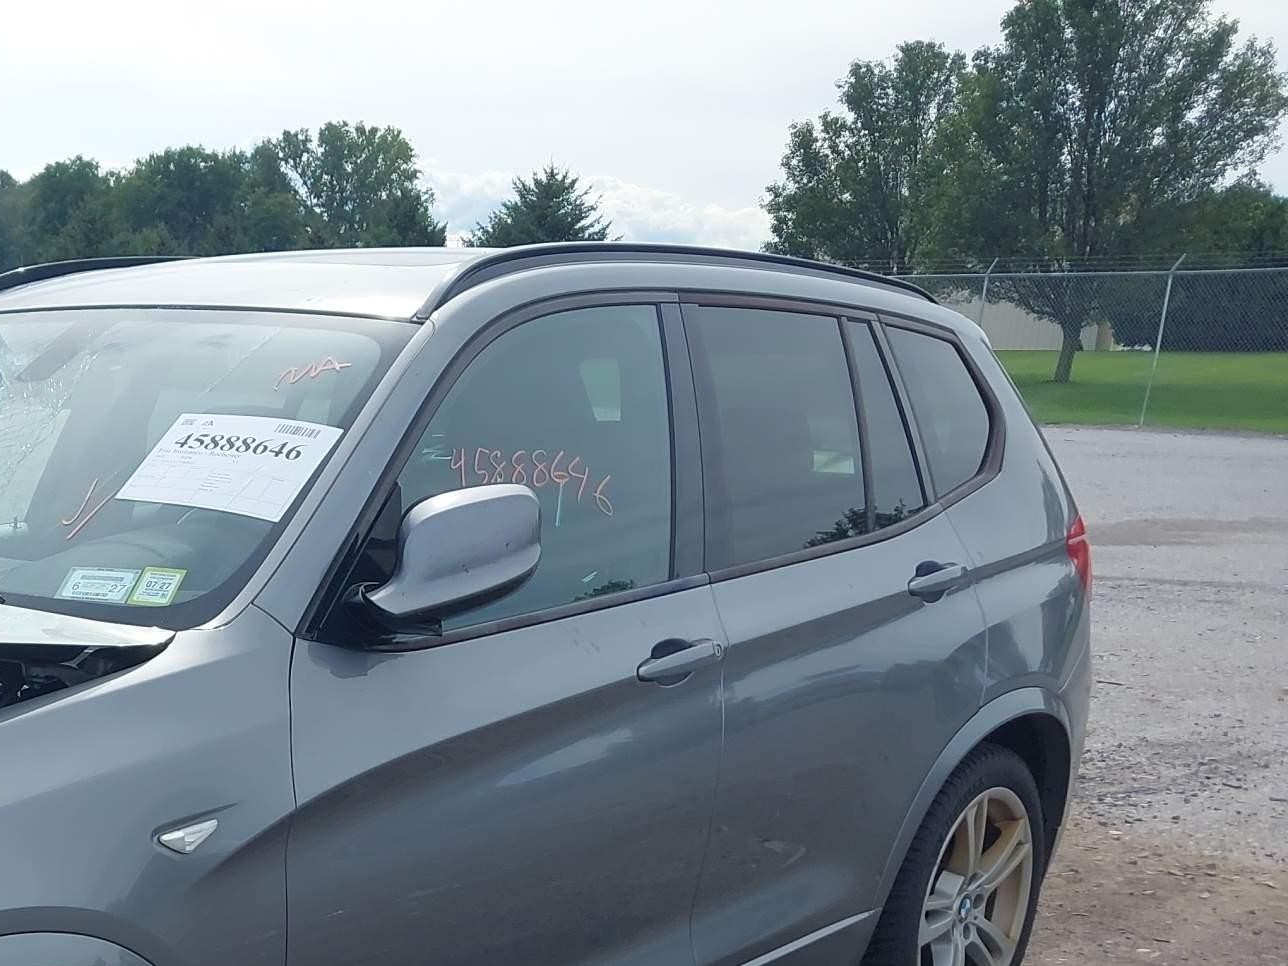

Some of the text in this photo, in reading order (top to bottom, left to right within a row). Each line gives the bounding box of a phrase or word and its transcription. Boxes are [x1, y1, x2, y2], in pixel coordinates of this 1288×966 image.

[174, 432, 306, 461] 45888646
[450, 447, 614, 516] 45888646
[72, 581, 81, 591] 6
[108, 584, 128, 593] 27
